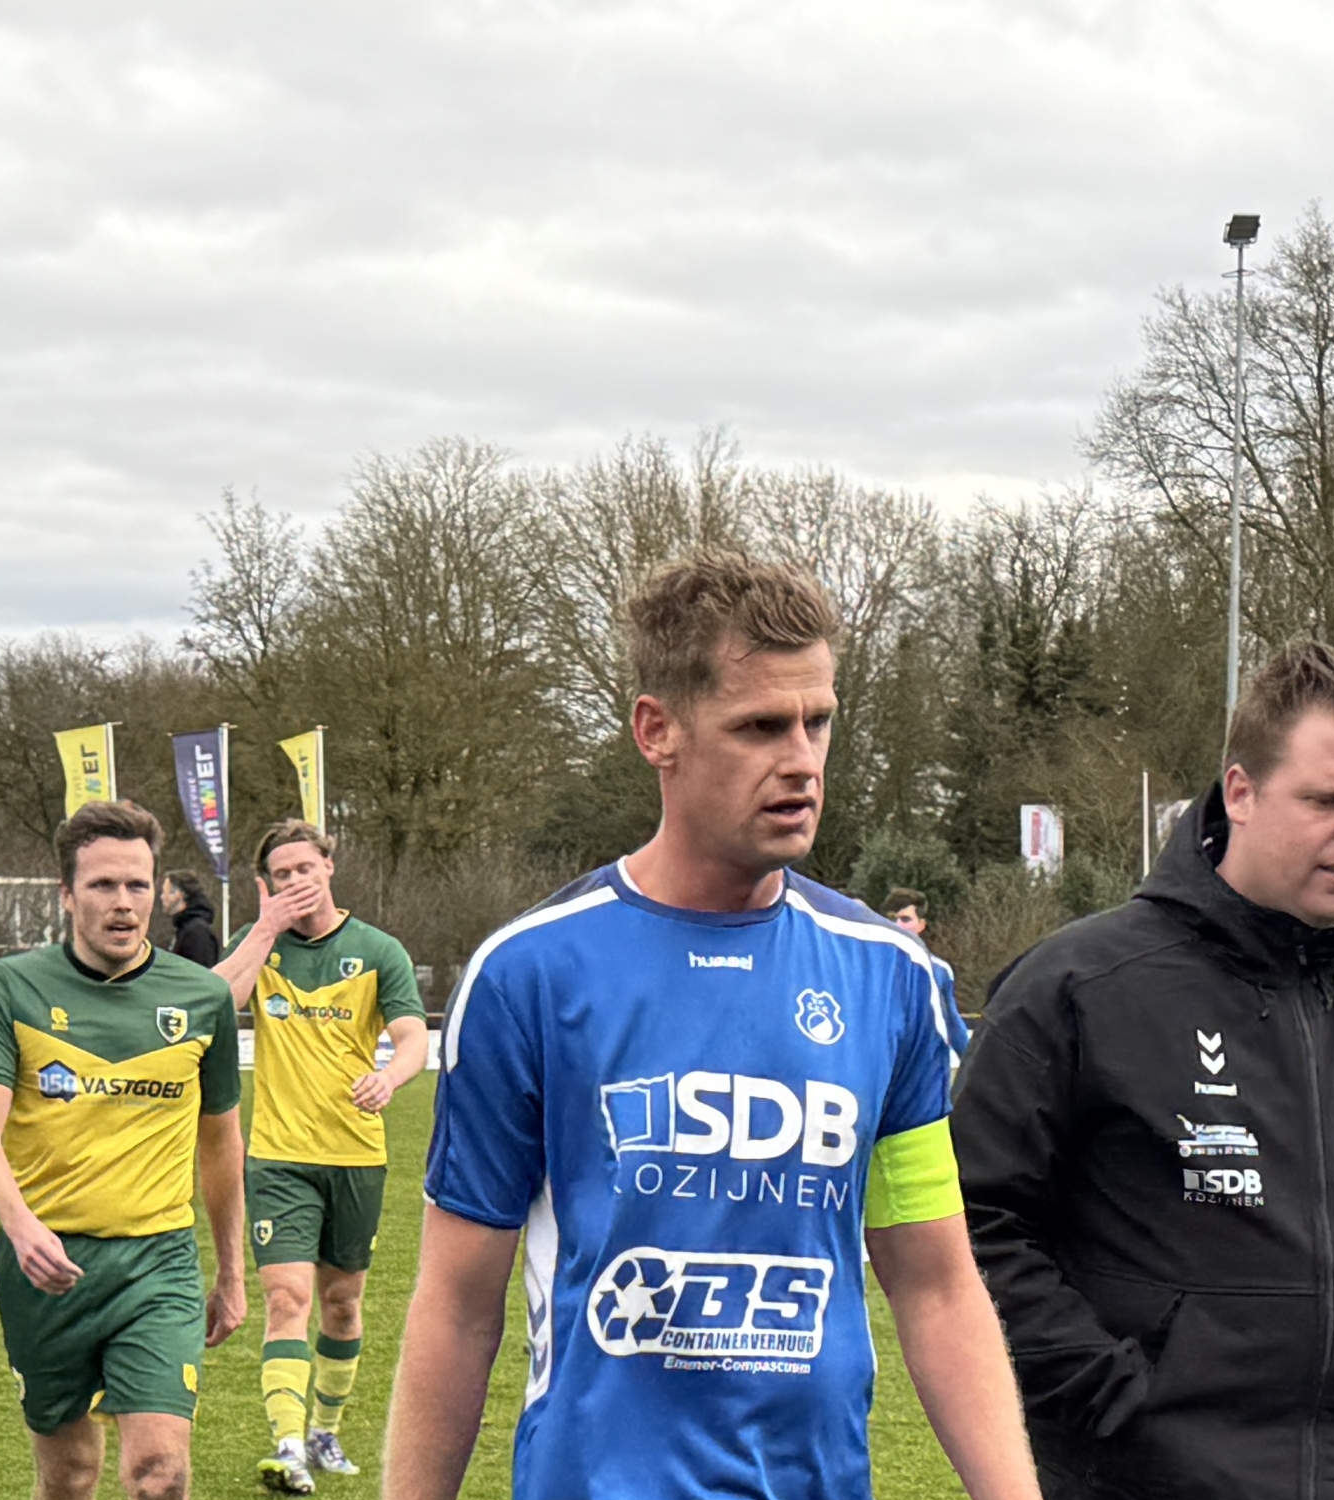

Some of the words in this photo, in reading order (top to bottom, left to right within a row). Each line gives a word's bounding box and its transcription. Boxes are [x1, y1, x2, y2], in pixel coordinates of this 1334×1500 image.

[688, 951, 753, 971] hummel
[81, 1076, 185, 1099] VASTGOED
[673, 1070, 860, 1167] SDB
[613, 1162, 849, 1212] OZIJNEN
[1205, 1169, 1263, 1195] SDB
[661, 1330, 815, 1354] CONTAINERVERHUUR
[663, 1355, 812, 1375] Emmer-Compascuum
